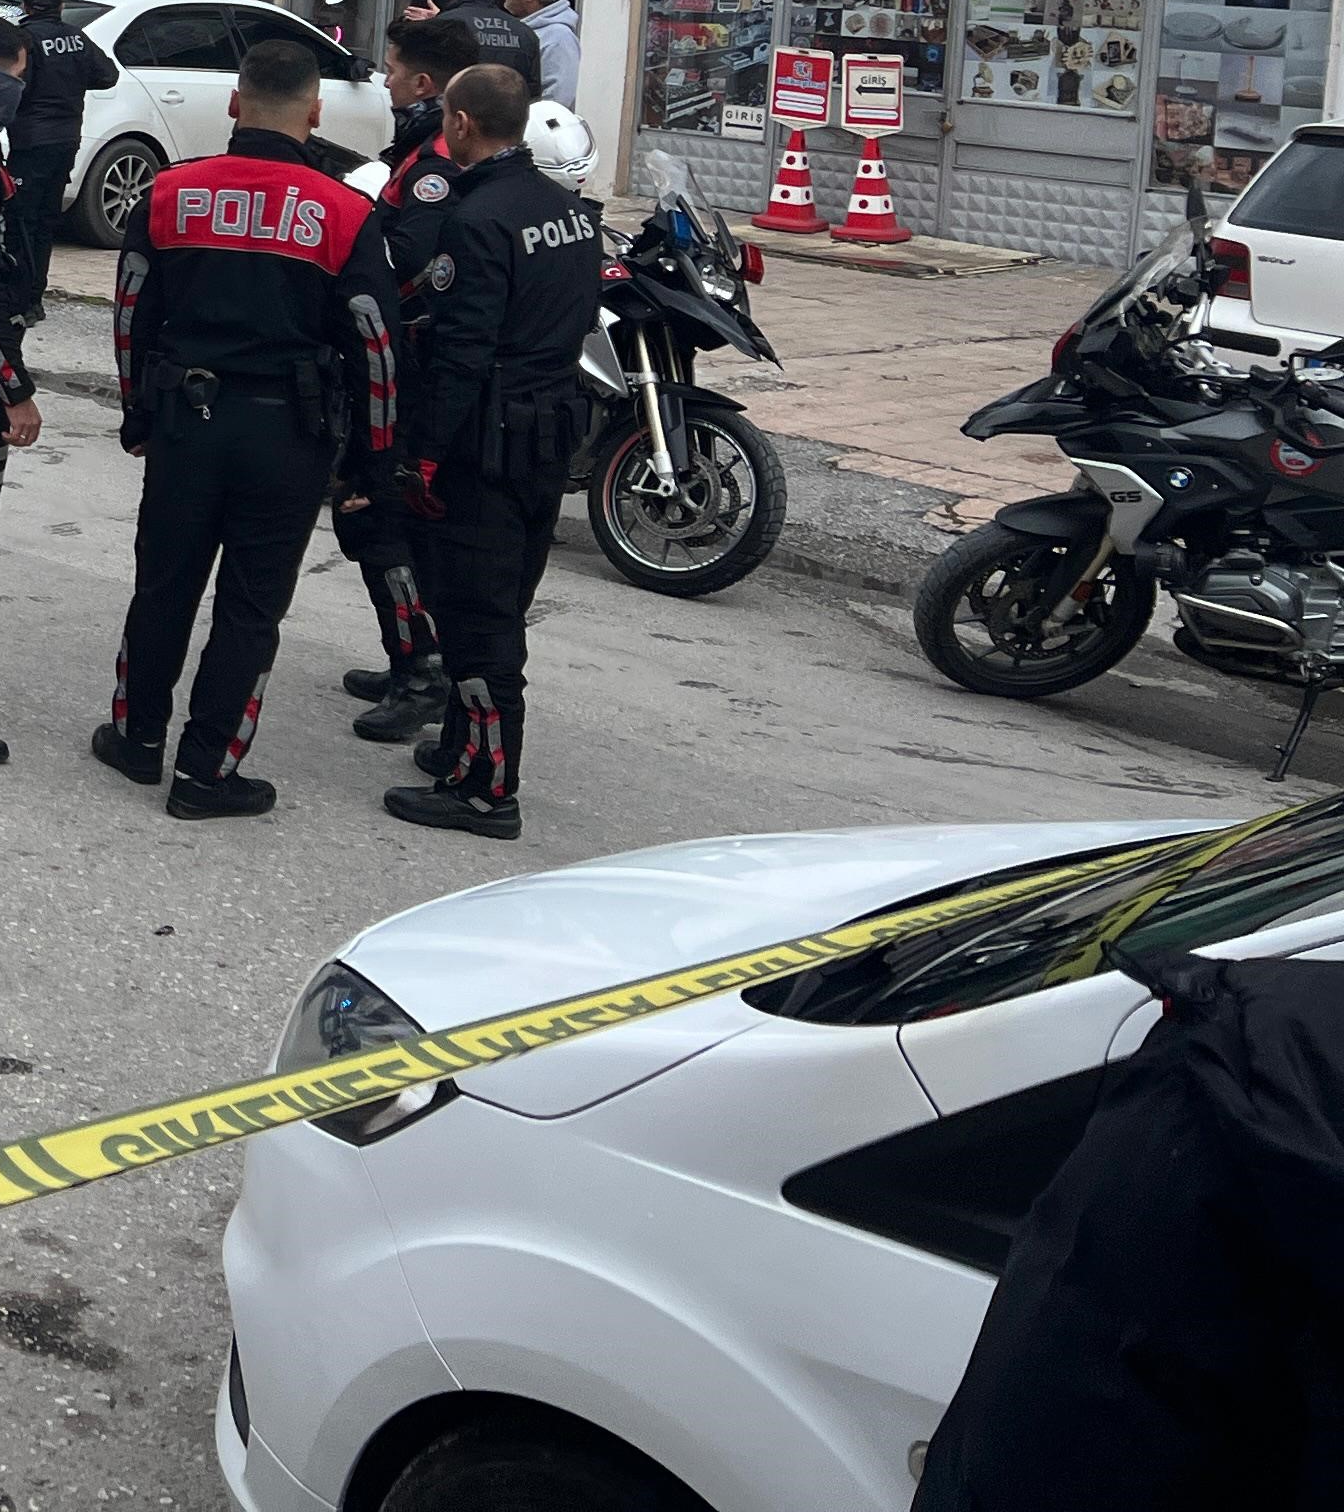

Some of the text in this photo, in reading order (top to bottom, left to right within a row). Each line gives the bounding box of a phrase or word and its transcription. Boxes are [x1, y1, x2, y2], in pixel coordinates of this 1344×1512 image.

[473, 16, 511, 32] ÖZEL
[477, 30, 521, 49] ÜVENLİK
[1109, 490, 1142, 504] GS
